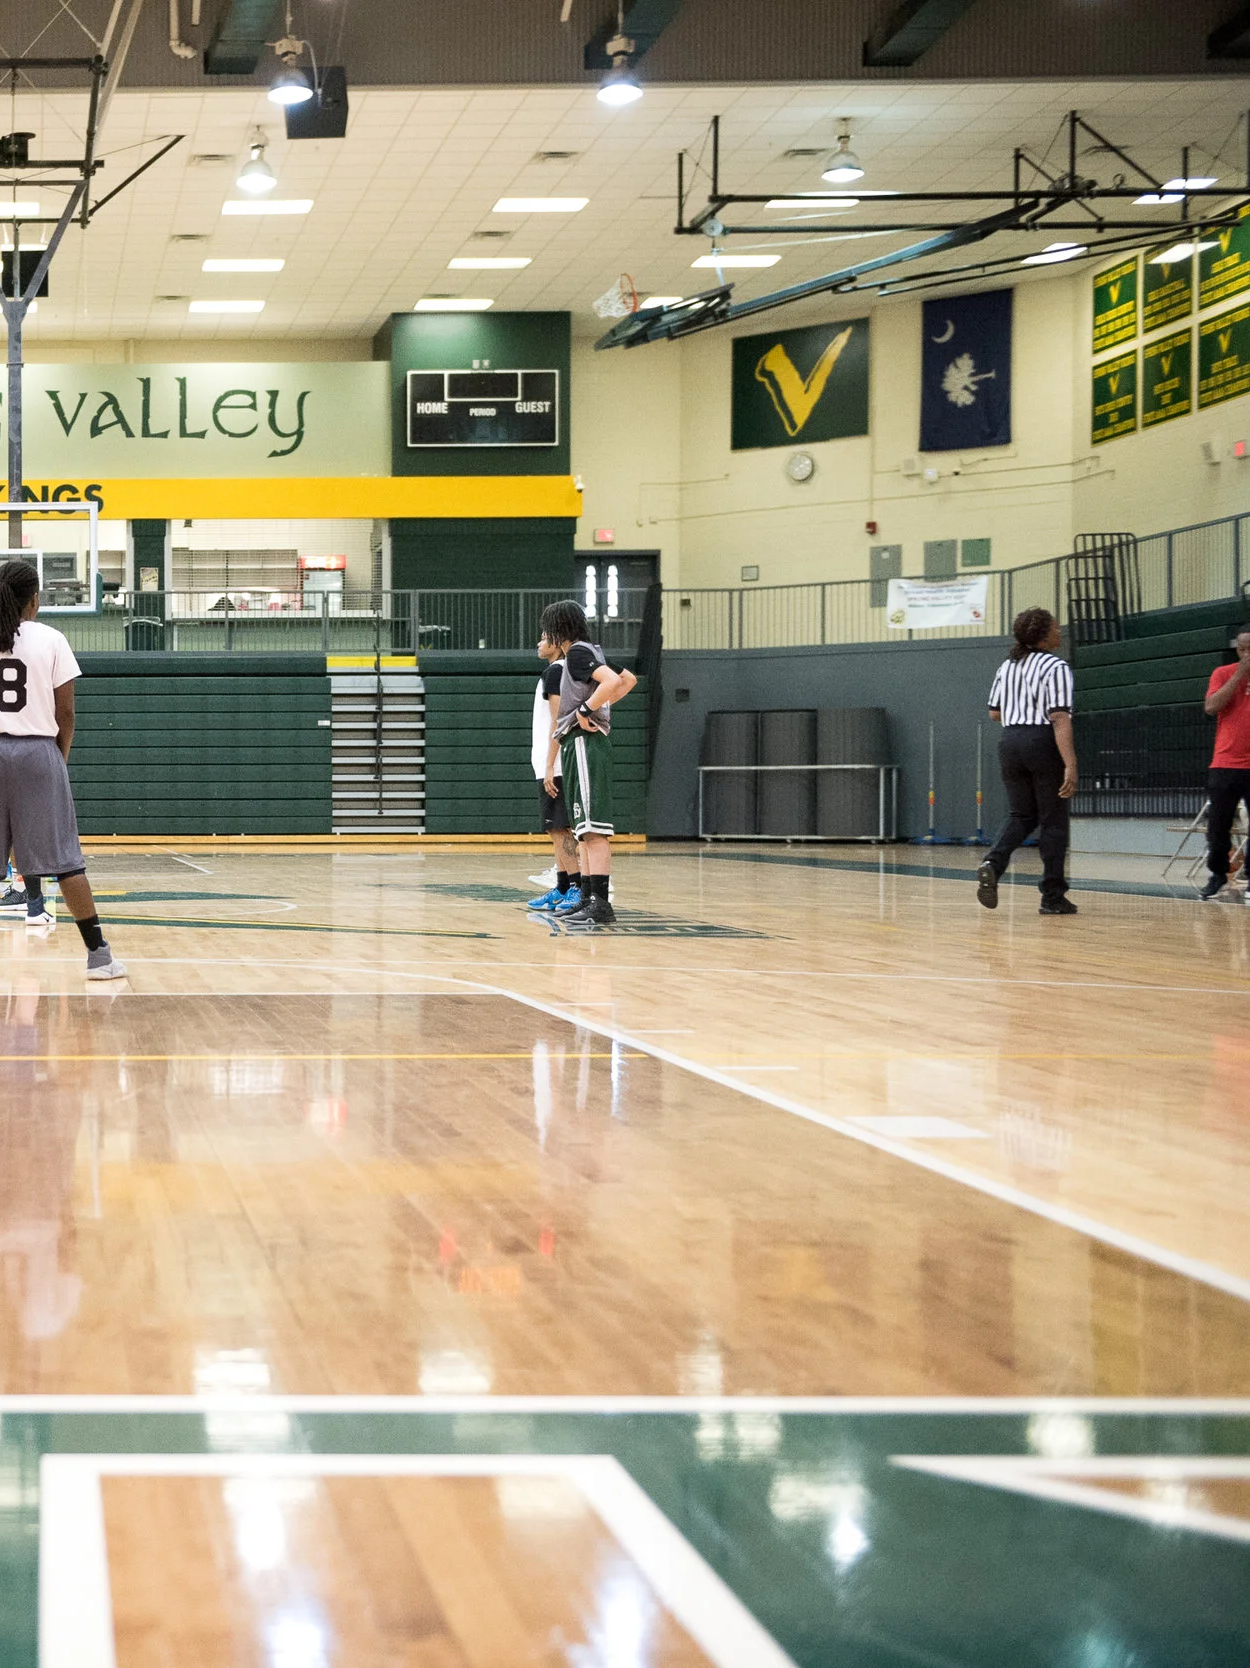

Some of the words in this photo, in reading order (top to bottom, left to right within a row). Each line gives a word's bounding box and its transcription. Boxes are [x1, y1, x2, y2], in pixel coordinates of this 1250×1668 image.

[417, 402, 448, 414] HOME
[469, 408, 496, 417] PERIOD
[515, 401, 551, 413] GUEST
